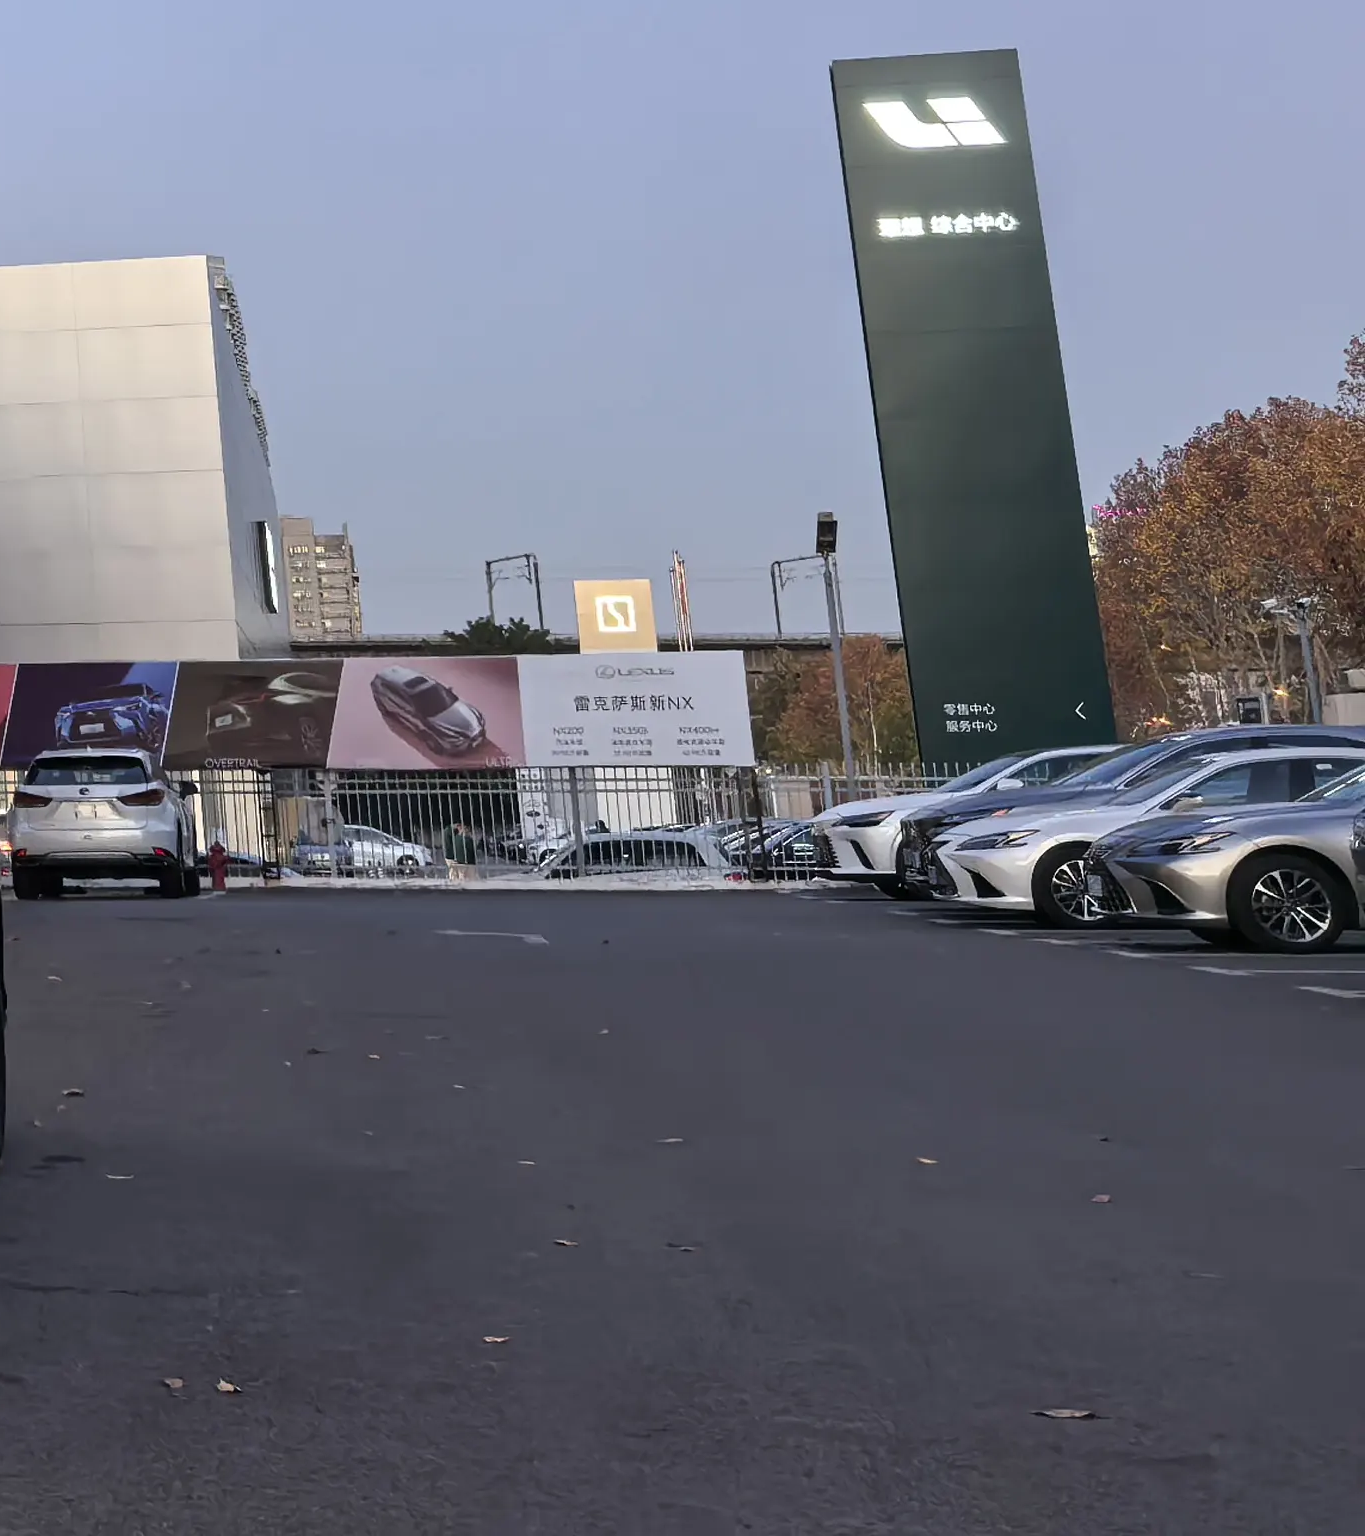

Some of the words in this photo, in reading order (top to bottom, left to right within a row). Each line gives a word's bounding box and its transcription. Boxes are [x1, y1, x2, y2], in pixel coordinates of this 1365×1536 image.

[573, 694, 695, 713] 雷克萨斯新NX
[943, 702, 996, 716] 零售中心
[945, 720, 998, 733] 服务中心
[205, 757, 263, 769] OVERTRAIL
